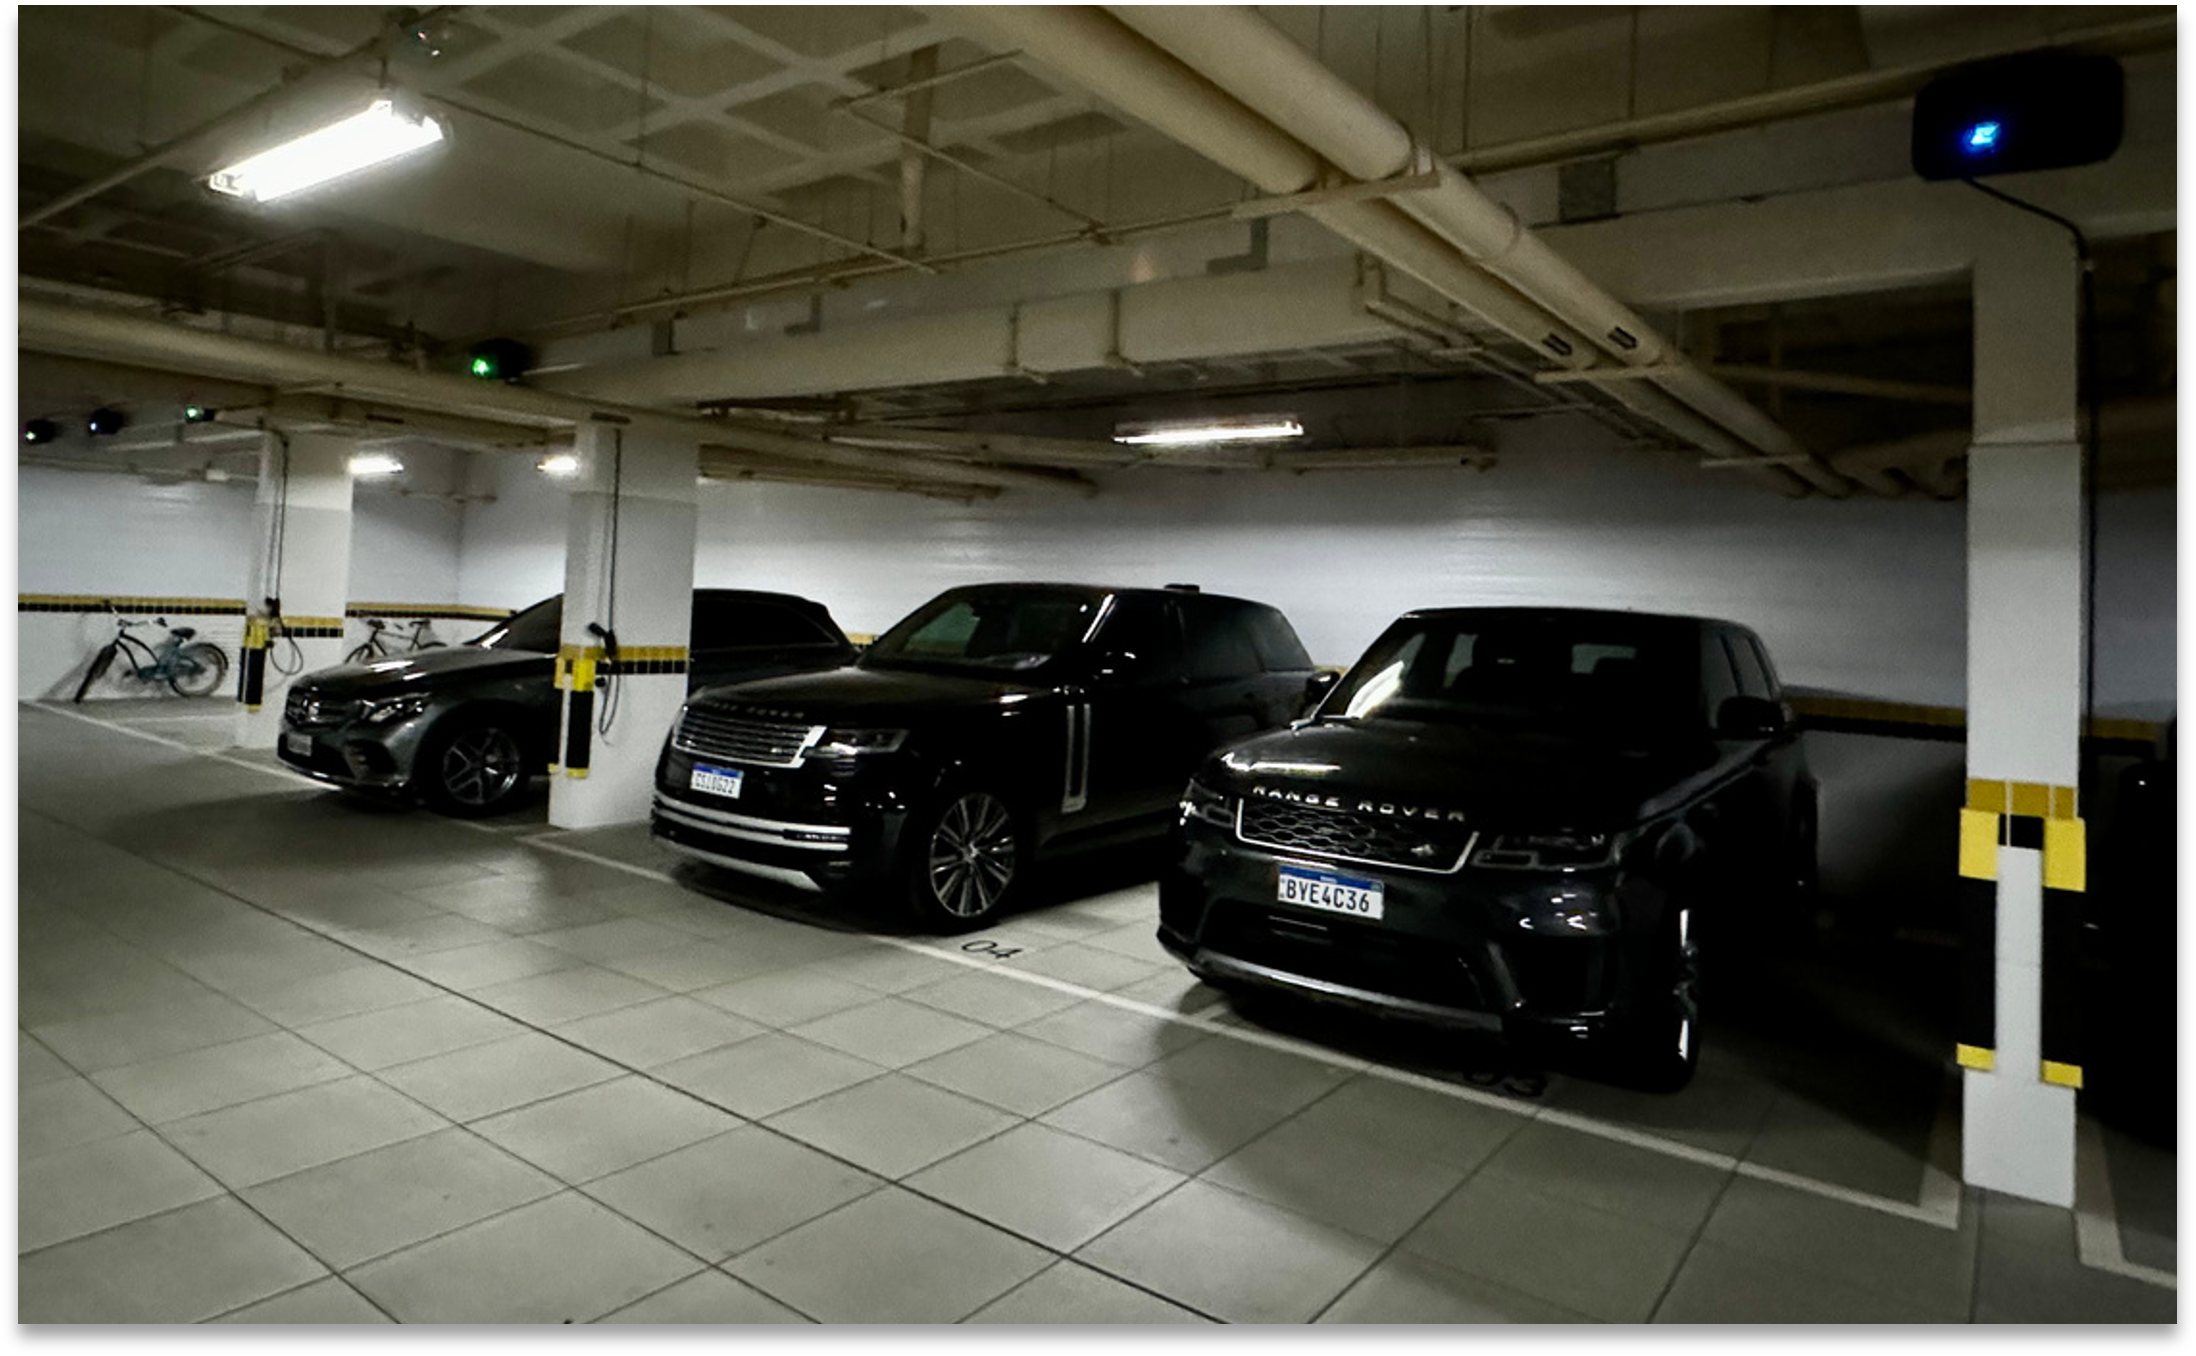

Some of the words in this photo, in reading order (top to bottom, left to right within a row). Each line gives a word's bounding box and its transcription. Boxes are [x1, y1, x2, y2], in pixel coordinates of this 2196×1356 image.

[1252, 785, 1341, 808] RANGE
[1357, 800, 1466, 822] ROVER
[1286, 879, 1370, 913] BYE4C36
[961, 940, 1023, 959] 04
